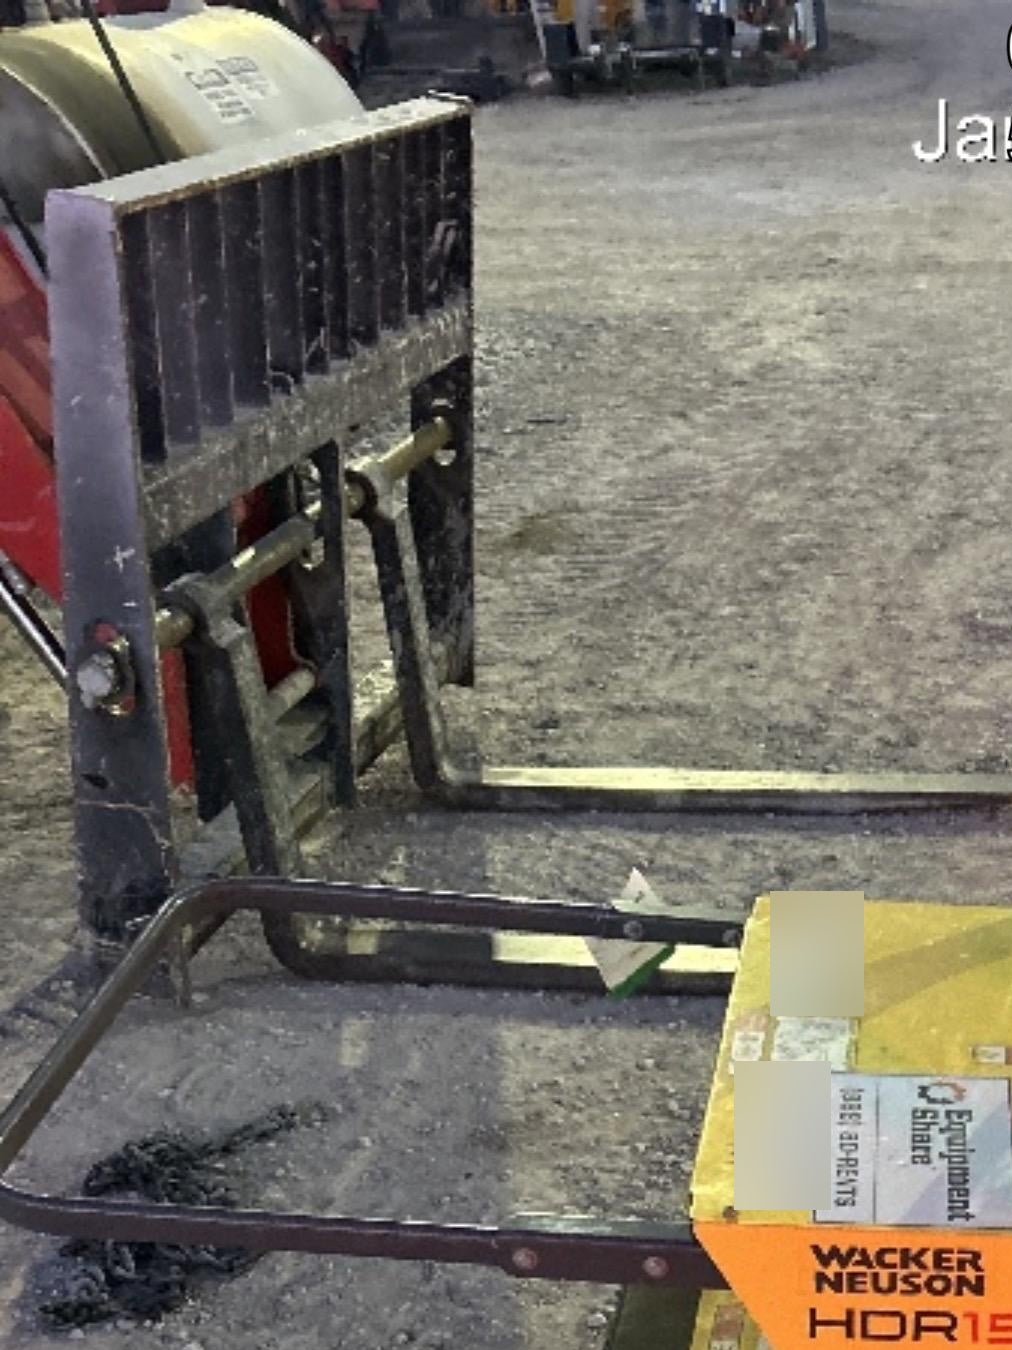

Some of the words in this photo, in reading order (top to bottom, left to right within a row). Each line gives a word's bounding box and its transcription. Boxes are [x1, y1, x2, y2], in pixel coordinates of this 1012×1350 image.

[911, 1107, 939, 1165] Share
[938, 1109, 976, 1222] Equipment
[810, 1244, 985, 1272] WACKER
[815, 1271, 985, 1297] NEUSON
